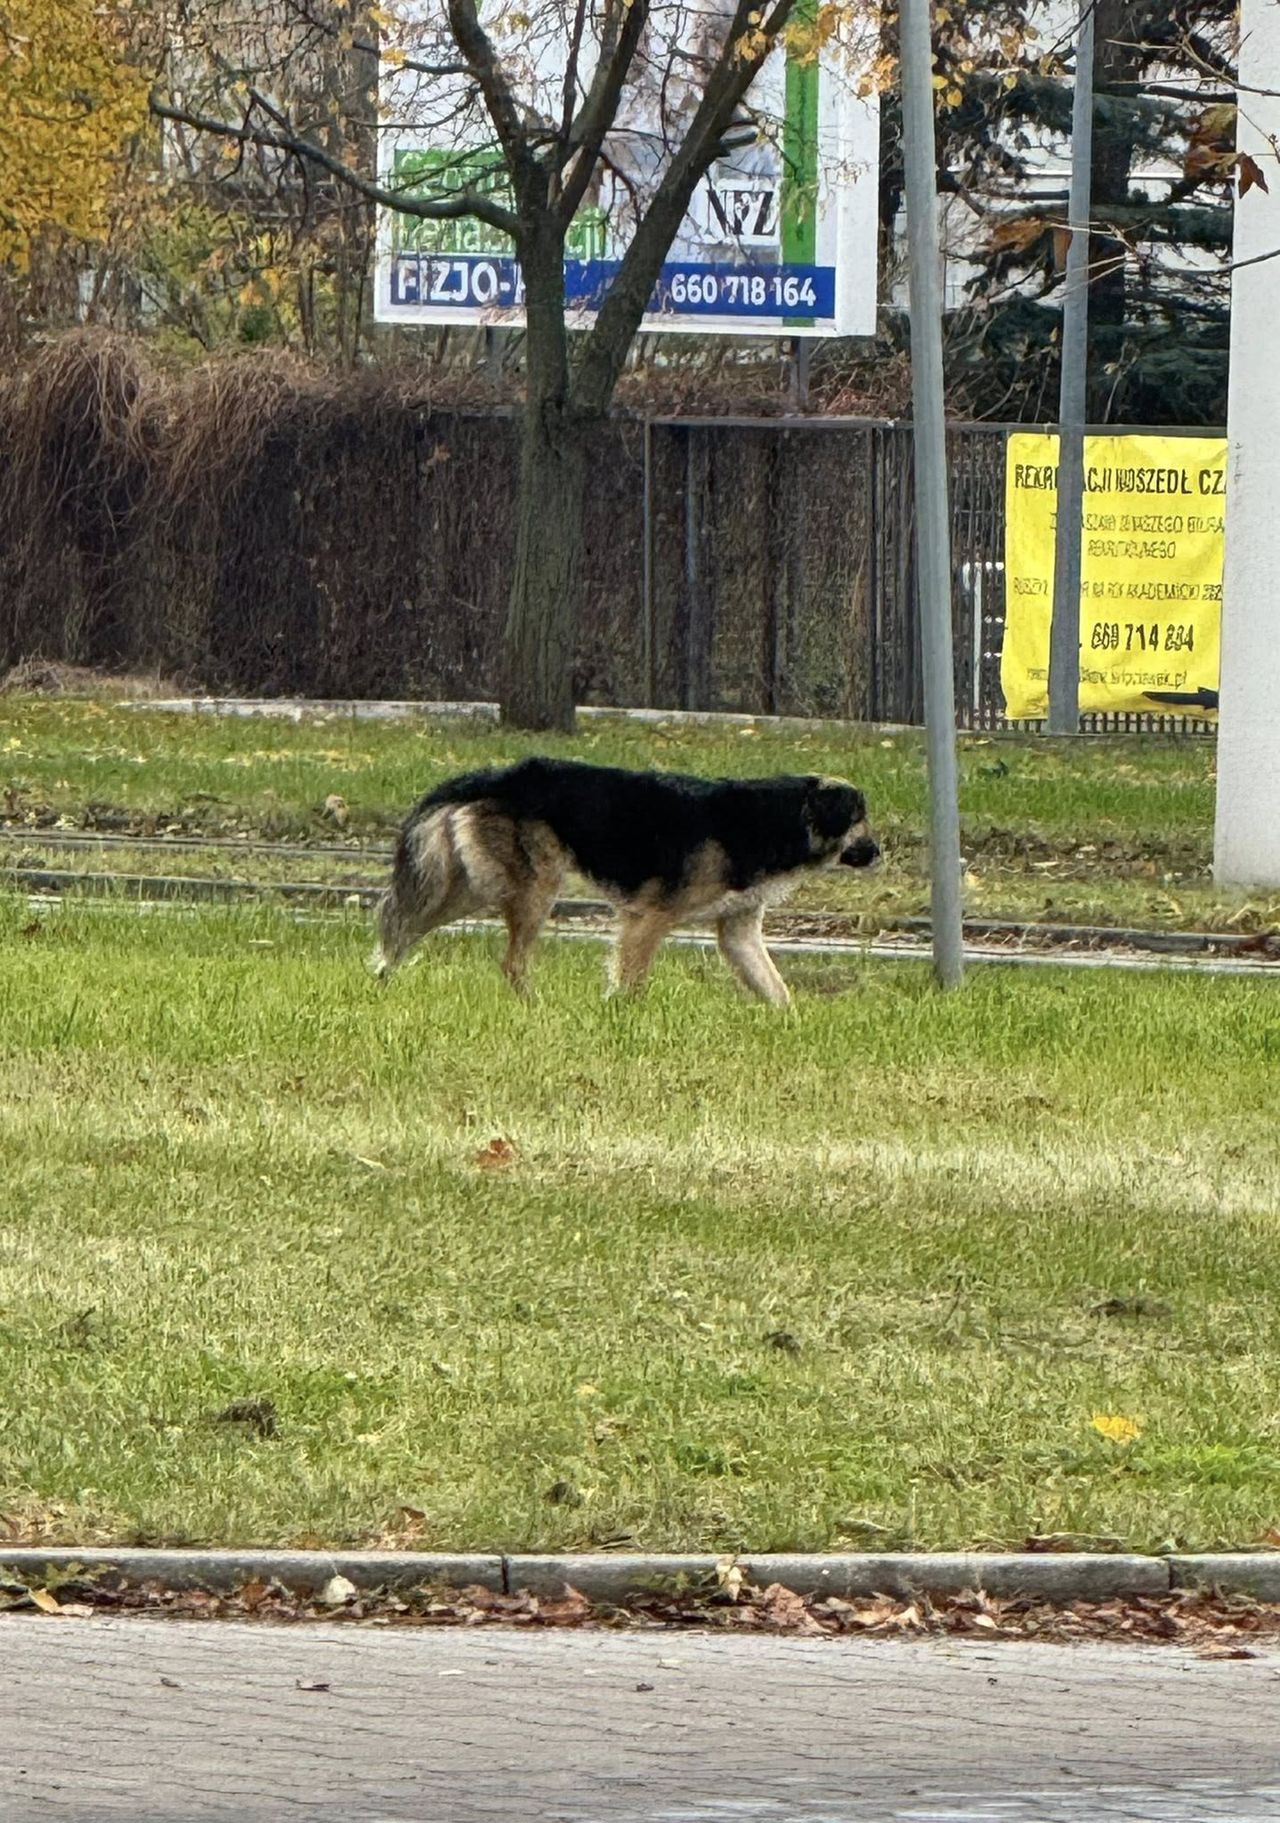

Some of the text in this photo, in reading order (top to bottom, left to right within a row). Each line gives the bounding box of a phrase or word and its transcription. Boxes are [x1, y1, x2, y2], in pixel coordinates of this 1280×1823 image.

[398, 260, 526, 304] FIZJO-
[671, 273, 816, 307] 660 718 164
[1199, 469, 1227, 495] CZ
[1125, 623, 1159, 652] 714
